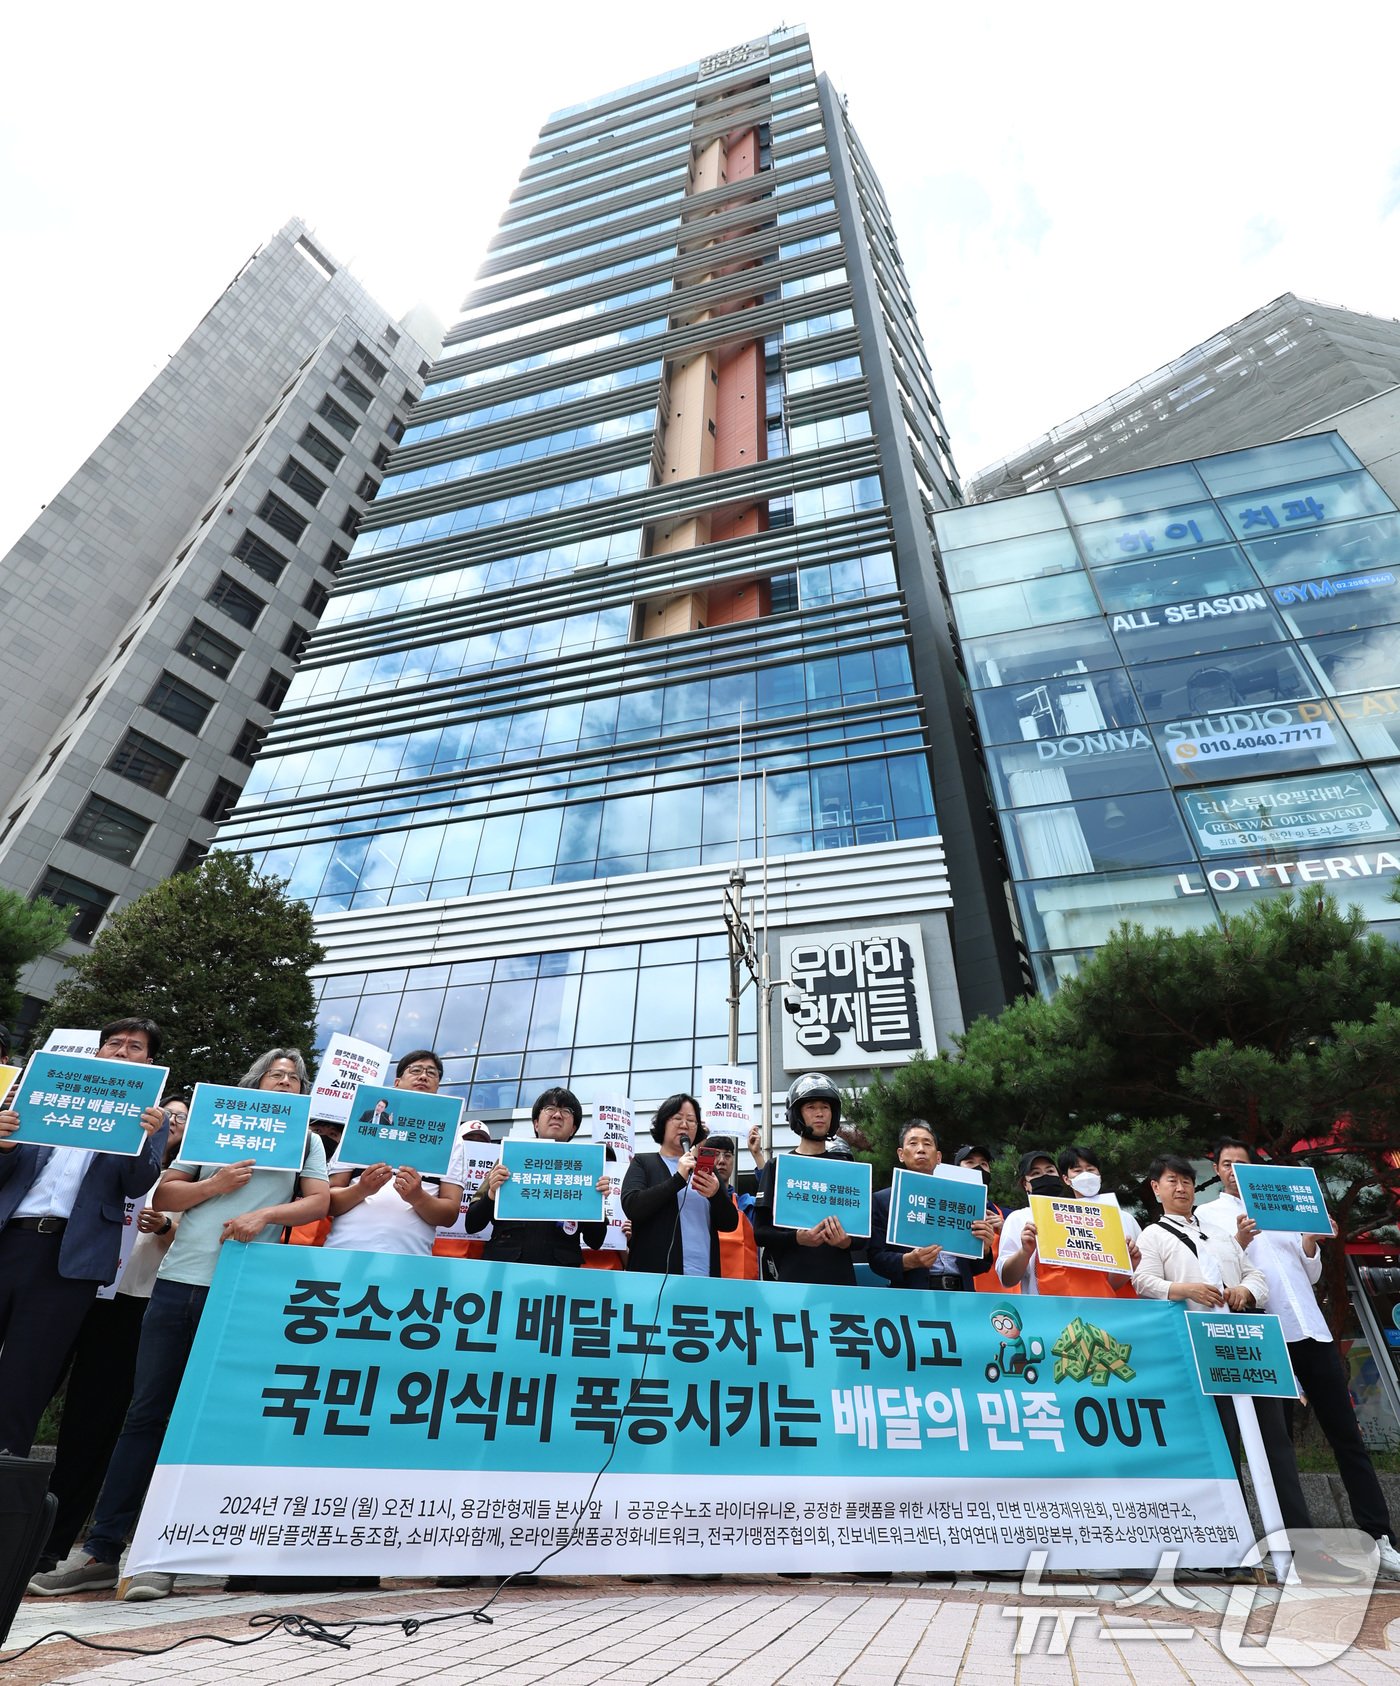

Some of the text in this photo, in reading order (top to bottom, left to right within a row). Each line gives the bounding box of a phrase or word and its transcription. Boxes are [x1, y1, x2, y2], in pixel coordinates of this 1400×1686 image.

[1116, 496, 1325, 552] 하이 치과
[1113, 611, 1159, 632] ALL
[1164, 592, 1267, 624] SEASON
[1273, 580, 1336, 605] GYM
[1037, 728, 1152, 761] DONNA
[1164, 708, 1293, 742] STUDIO
[1200, 727, 1322, 756] 010.4040.7717
[1197, 785, 1361, 815] 도나스튜디오필라테스
[1212, 806, 1365, 834] RENEWAL OPEN EVENT
[1219, 836, 1237, 847] 최대
[1347, 820, 1372, 834] 증정
[1178, 852, 1400, 895] LOTTERIA
[791, 936, 912, 994] 우아한
[793, 988, 918, 1052] 형제들
[47, 1068, 82, 1082] 중소상인
[83, 1073, 126, 1087] 배달노동자
[82, 1085, 108, 1096] 외식비
[29, 1090, 142, 1118] 플랫폼만 배불리는
[214, 1098, 292, 1116] 공정한 시장질서
[714, 1102, 743, 1112] 소비자도
[42, 1111, 116, 1133] 수수료 인상
[211, 1113, 288, 1134] 자율규제는
[397, 1115, 446, 1132] 말로만 민생
[215, 1132, 277, 1152] 부족하다
[358, 1125, 444, 1145] 대체 온플법은 언제?
[603, 1131, 629, 1142] 소비자도
[524, 1158, 583, 1171] 온라인플랫폼
[511, 1173, 593, 1187] 독점규제 공정화법
[786, 1178, 861, 1197] 음식값 폭등 유발하는
[520, 1188, 583, 1201] 즉각 처리하라
[786, 1191, 861, 1208] 수수료 인상 철회하라
[907, 1193, 976, 1217] 이익은 플랫폼이
[1084, 1205, 1101, 1216] 위한
[907, 1211, 936, 1225] 손해는
[1054, 1212, 1104, 1228] 음식값 상승
[1066, 1238, 1103, 1252] 소비자도
[282, 1279, 962, 1372] 중소상인 배달노동자 다 죽이고
[1216, 1345, 1262, 1361] 독일 본사
[1209, 1367, 1278, 1384] 배당금 4천억
[261, 1364, 1168, 1452] 국민 외식비 폭등시키는 배달의 민족 OUT
[219, 1496, 1197, 1521] 2024년 7월 15일 (월) 오전 11시, 용감한형제들 본사 앞 공공운수노조 라이더유니온, 공정한 플랫폼을 위한 사장님 모임, 민변 민생경제위원회, 민생경제연구소,
[158, 1523, 1240, 1549] 서비스연맹 배달플랫폼노동조합, 소비자와함께, 온라인플랫폼공정화네트워크, 전국가맹점주협의회, 진보네트워크센터, 참여연대 민생희망본부, 한국중소상인자영업자총연합회
